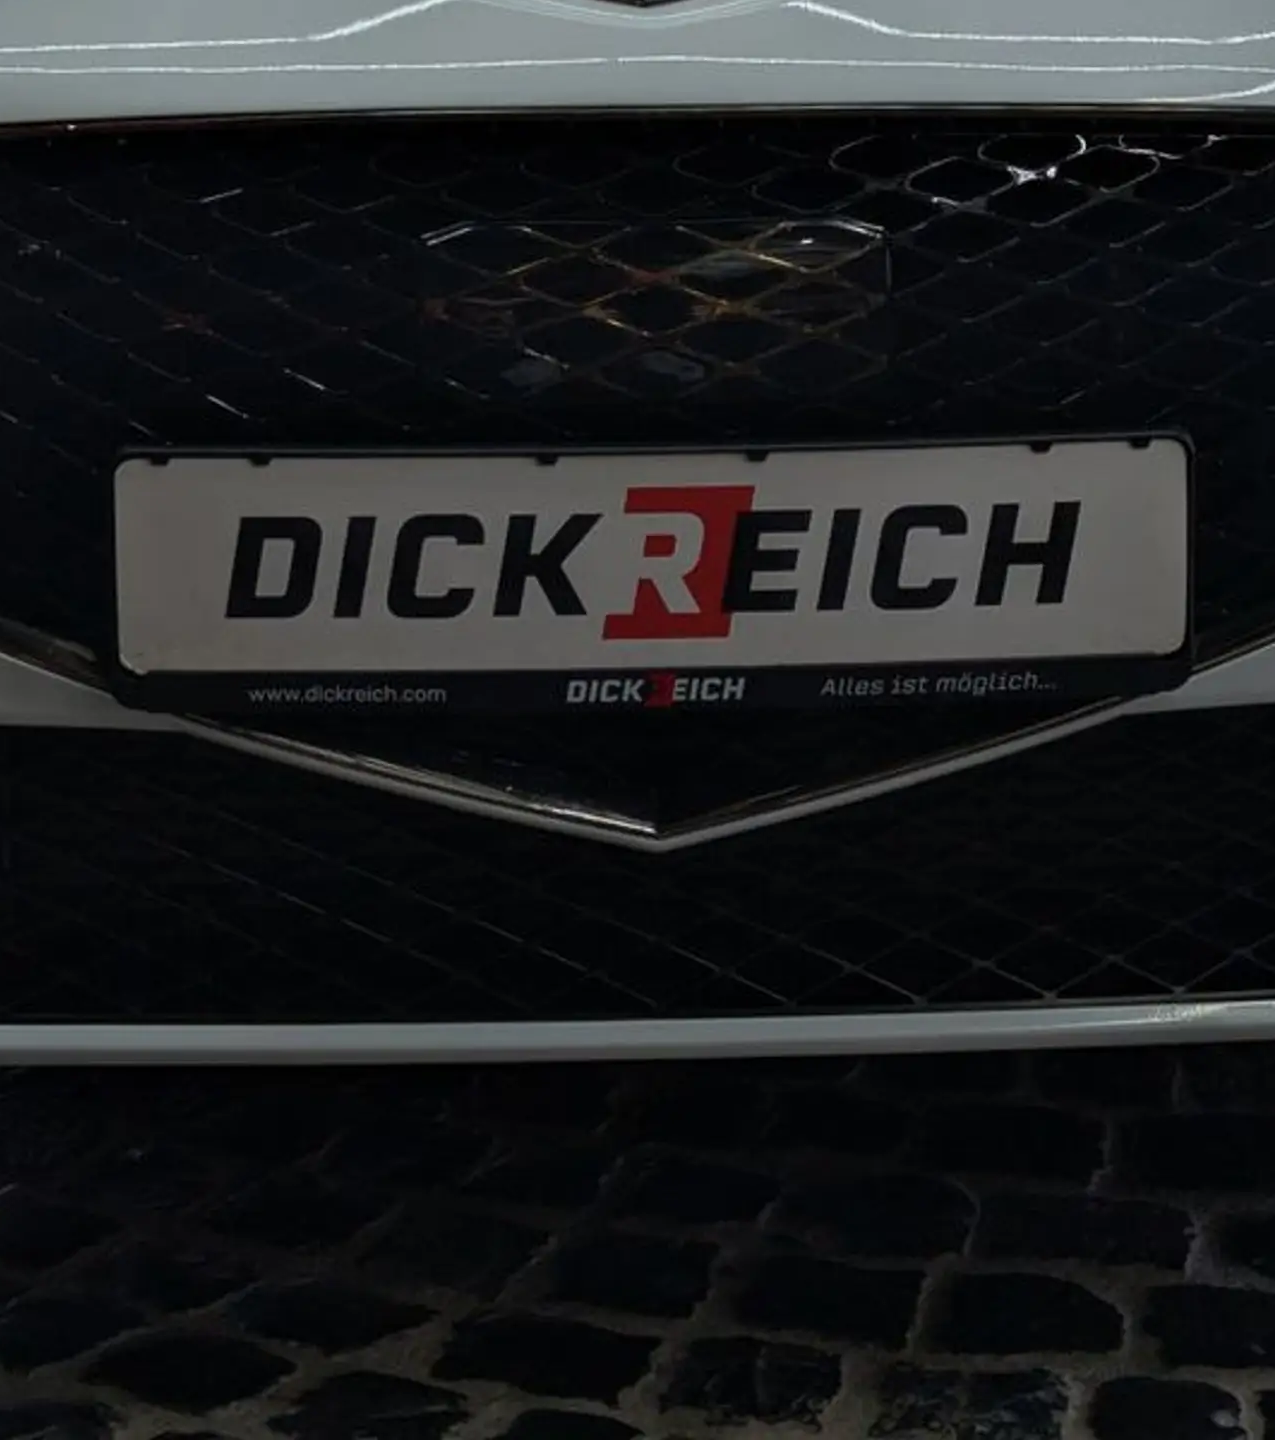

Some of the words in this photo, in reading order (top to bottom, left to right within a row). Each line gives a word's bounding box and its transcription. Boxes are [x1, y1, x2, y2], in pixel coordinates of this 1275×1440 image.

[225, 498, 1082, 620] DICKREICH
[247, 683, 448, 704] www.dickreich.com
[820, 675, 885, 697] Alles
[891, 674, 930, 696] ist
